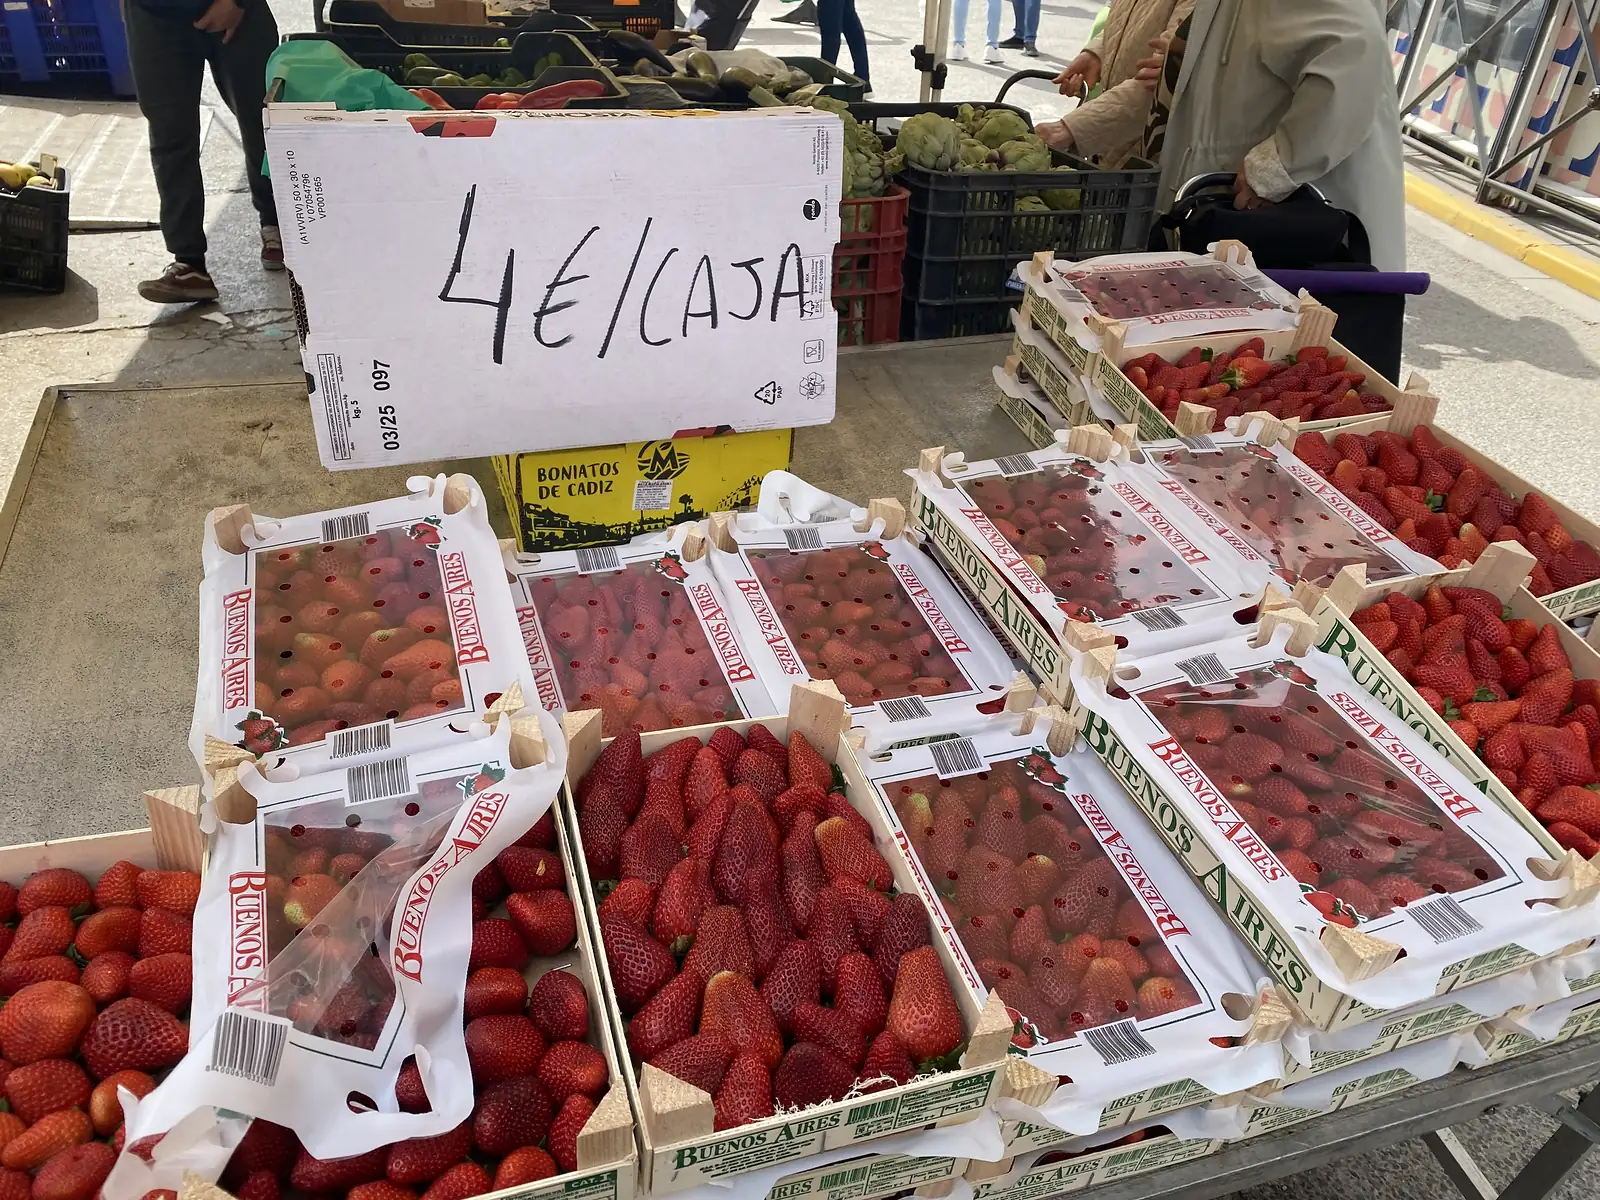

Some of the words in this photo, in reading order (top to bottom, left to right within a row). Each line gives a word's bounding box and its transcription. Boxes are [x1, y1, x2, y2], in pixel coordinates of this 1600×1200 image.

[286, 150, 295, 161] 10
[290, 170, 299, 182] 30
[293, 190, 302, 201] 50
[301, 173, 315, 216] 07054796
[313, 176, 327, 220] VP001565
[804, 200, 817, 219] rondo
[1147, 311, 1204, 325] BUENOS
[1204, 308, 1251, 321] AIRES
[371, 359, 391, 391] 097
[764, 388, 771, 398] 20
[352, 406, 362, 419] kg.
[378, 404, 401, 451] 03/25
[537, 461, 620, 483] BONIATOS
[538, 485, 560, 500] DE
[567, 480, 614, 497] CADIZ
[1111, 482, 1153, 516] AIRES
[1149, 512, 1211, 565] BUENOS
[1287, 464, 1331, 498] AIRES
[1328, 494, 1394, 544] BUENOS
[443, 552, 476, 598] AIRES
[959, 507, 1012, 561] BUENOS
[1002, 555, 1048, 596] AIRES
[895, 563, 933, 609] AIRES
[917, 496, 989, 591] BUENOS
[990, 587, 1057, 675] AIRES
[223, 588, 252, 653] BUENOS
[448, 595, 491, 666] BUENOS
[692, 584, 726, 632] AIRES
[712, 622, 755, 685] BUENOS
[734, 578, 781, 637] BUENOS
[764, 630, 803, 676] AIRES
[912, 600, 971, 655] BUENOS
[515, 605, 545, 666] BUENOS
[530, 663, 562, 712] AIRES
[220, 654, 250, 711] AIRES
[1331, 691, 1400, 742] AIRES
[1385, 738, 1483, 819] BUENOS
[1148, 737, 1231, 827] BUENOS
[1212, 819, 1289, 883] AIRES
[1072, 792, 1126, 849] AIRES
[1107, 843, 1192, 938] BUENOS
[1079, 709, 1195, 854] BUENOS
[1198, 862, 1308, 995] AIRES
[394, 856, 450, 984] BUENOS
[450, 790, 507, 865] AIRES
[228, 871, 267, 971] BUENOS
[956, 1078, 980, 1088] CAT.
[673, 1132, 768, 1171] BUENOS
[772, 1112, 842, 1144] AIRES
[571, 1177, 599, 1189] CAT.
[769, 1179, 813, 1200] IRES
[1047, 1158, 1101, 1183] AIRES
